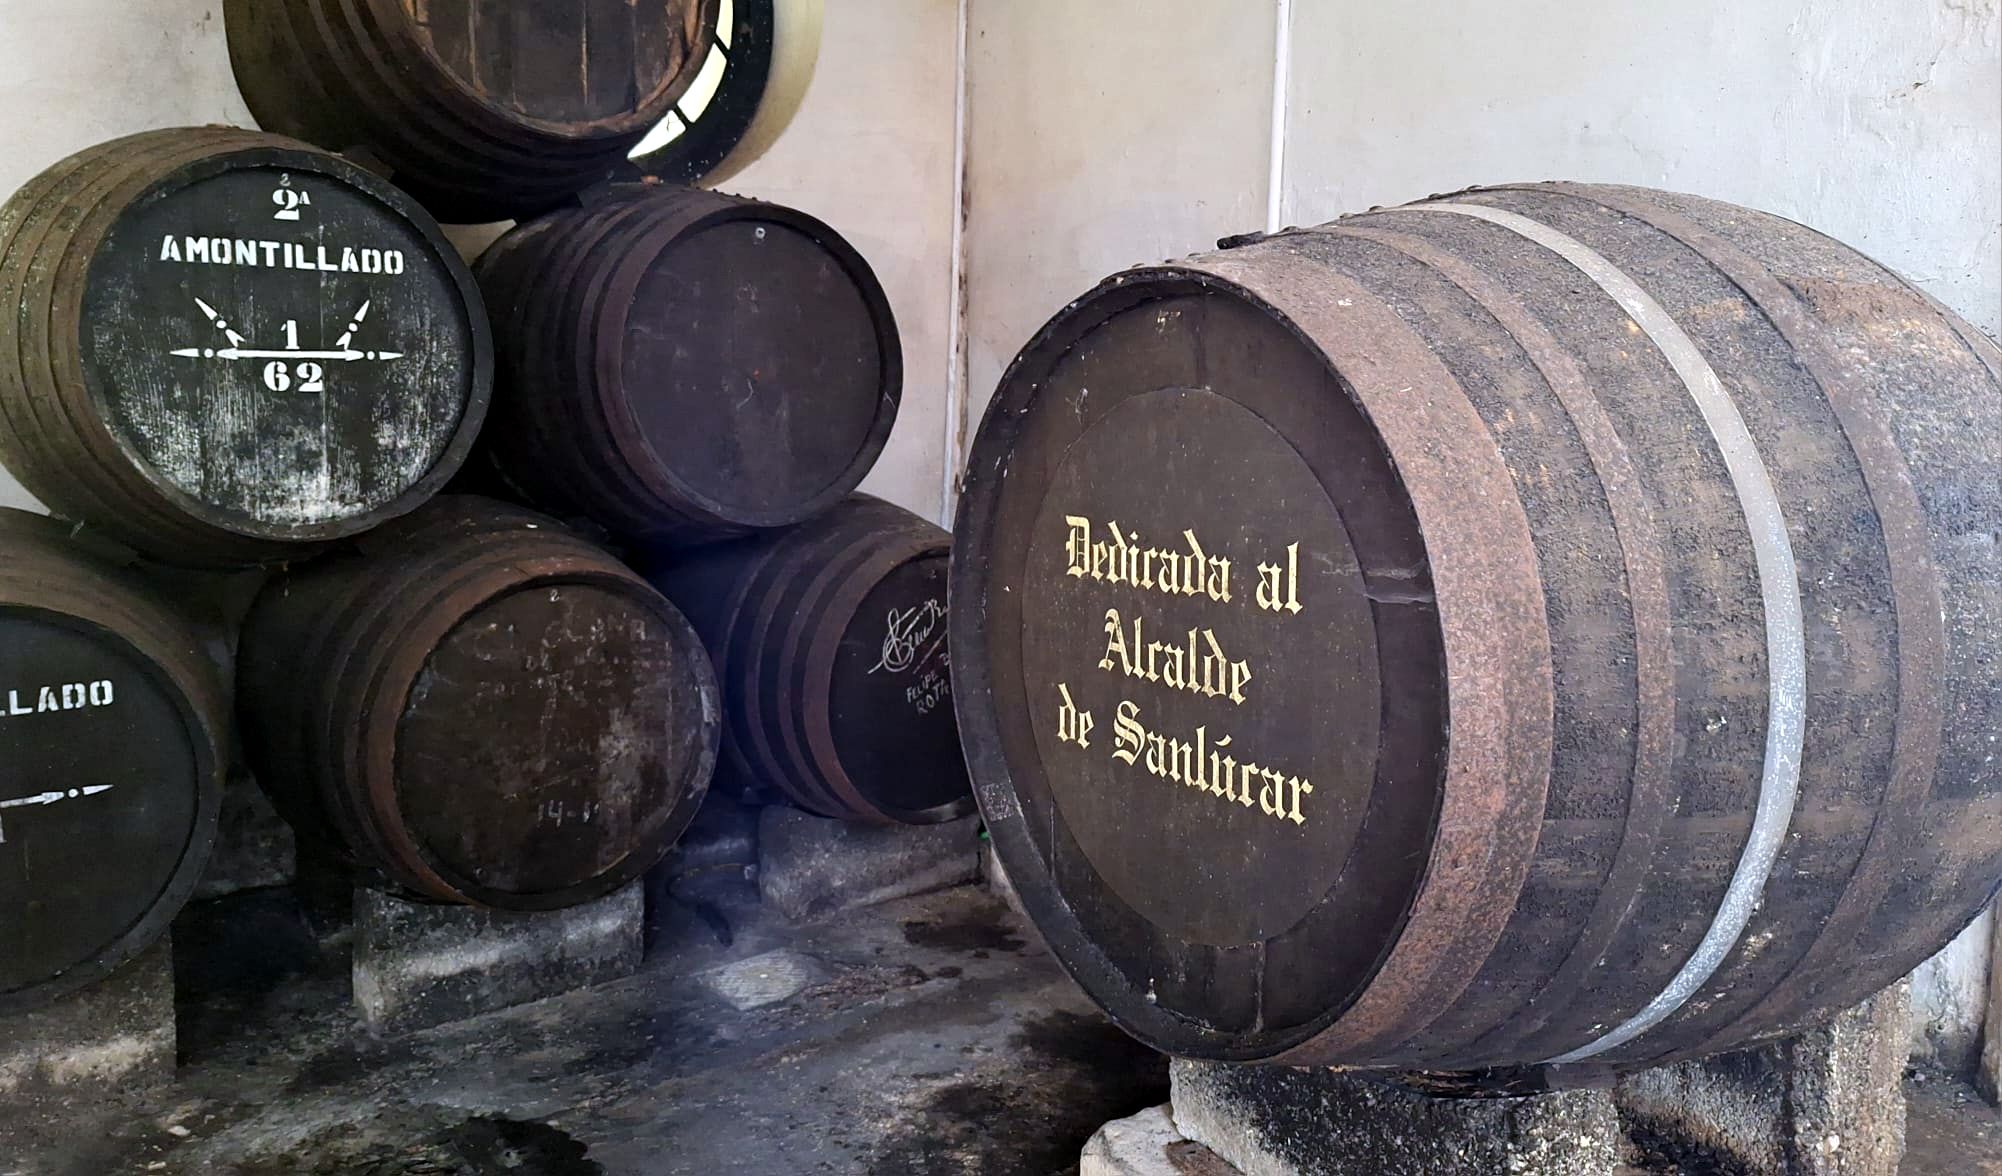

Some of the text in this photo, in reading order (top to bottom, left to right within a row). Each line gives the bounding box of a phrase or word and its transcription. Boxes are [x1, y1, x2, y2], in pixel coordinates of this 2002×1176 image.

[160, 235, 404, 275] AMONTILLADO
[280, 319, 300, 350] 1
[263, 361, 323, 392] 62
[1065, 515, 1303, 615] Dedicada al
[1098, 608, 1252, 705] Alcalde
[0, 680, 113, 717] LADO
[1057, 683, 1314, 825] de Sanlúcar
